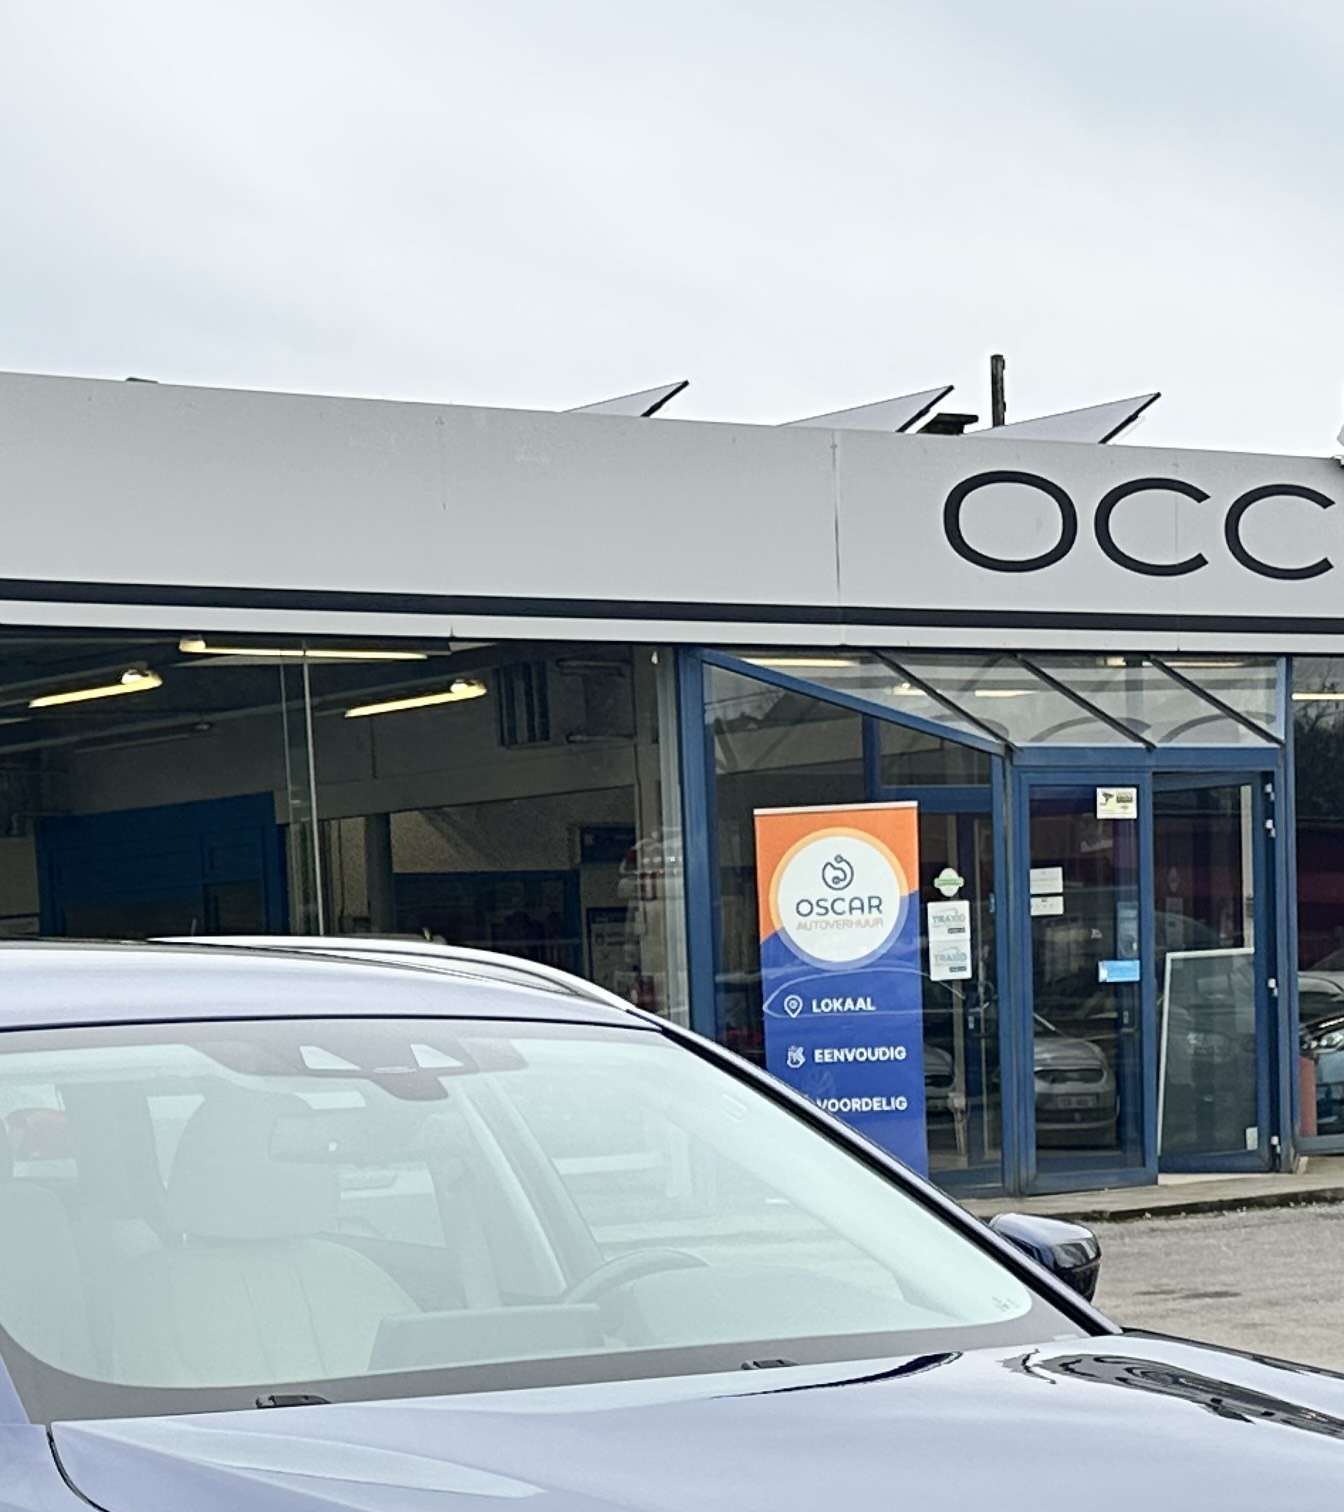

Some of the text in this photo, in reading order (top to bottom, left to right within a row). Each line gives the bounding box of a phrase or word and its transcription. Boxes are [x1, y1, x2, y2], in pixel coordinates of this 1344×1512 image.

[796, 896, 883, 917] OSCAR
[812, 997, 876, 1013] LOKAAL
[814, 1046, 907, 1063] EENVOUDIG
